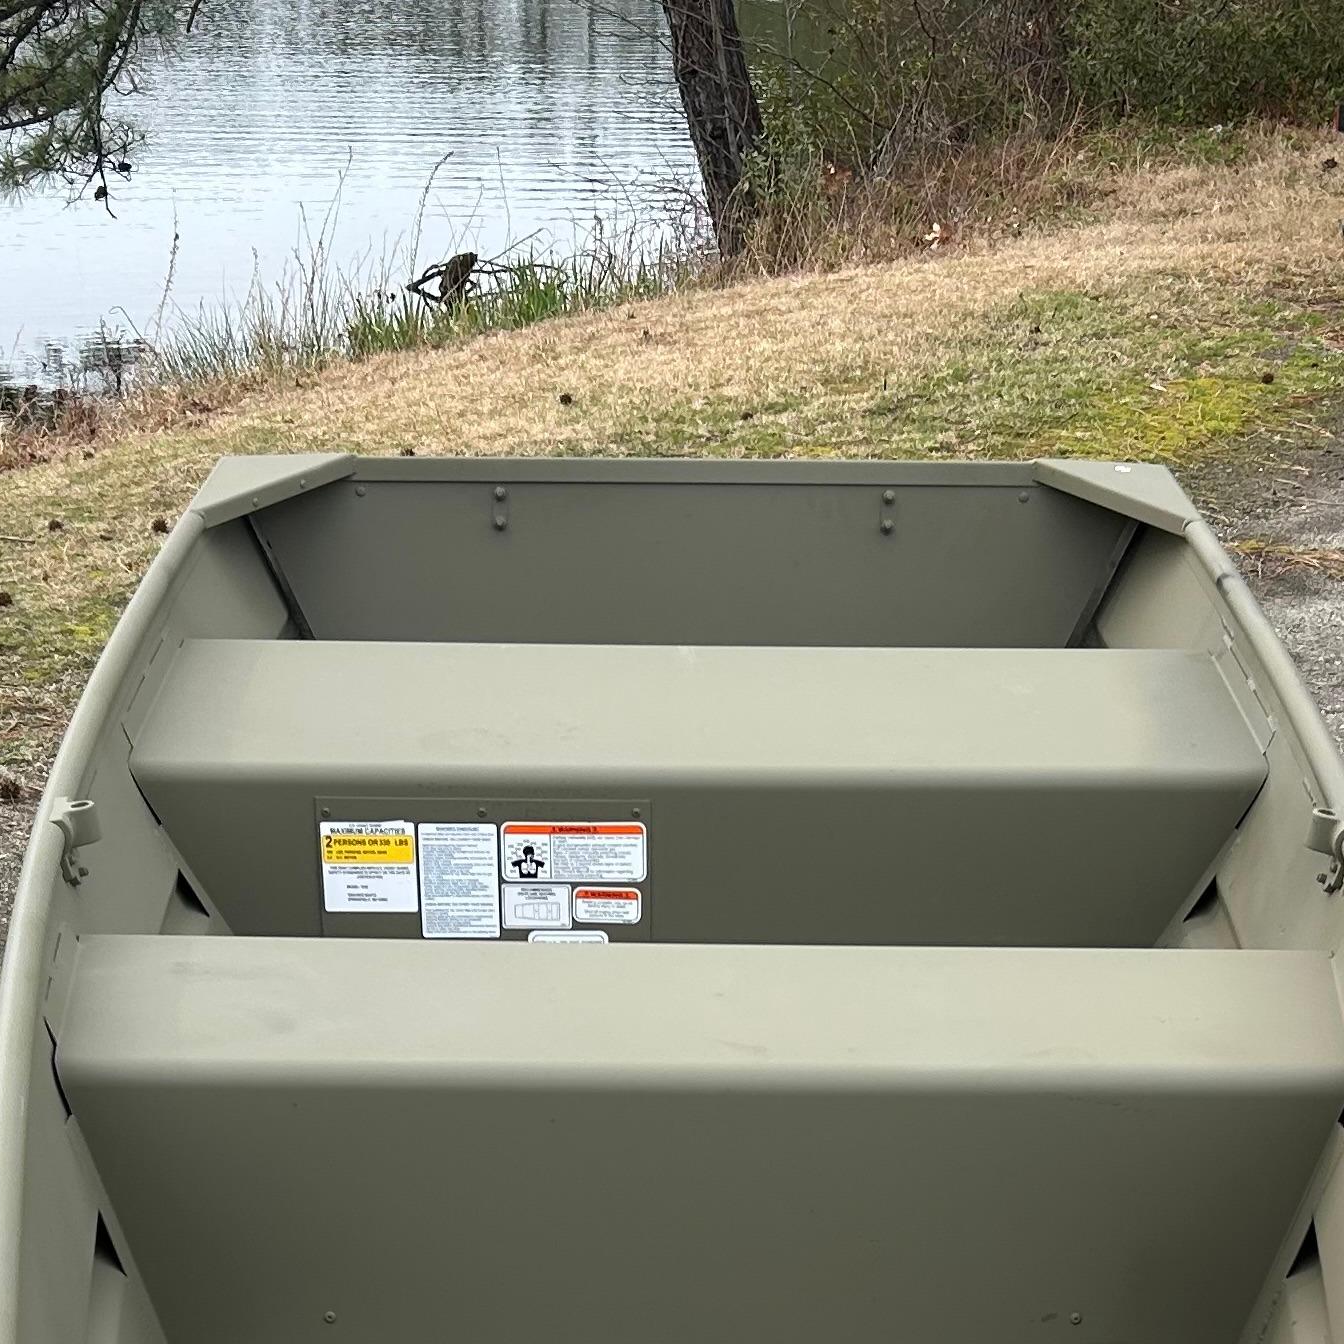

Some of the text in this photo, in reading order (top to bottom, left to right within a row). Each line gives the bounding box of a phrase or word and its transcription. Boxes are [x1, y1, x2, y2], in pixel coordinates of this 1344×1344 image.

[325, 835, 333, 848] 2
[333, 838, 366, 846] PERSONS
[368, 838, 378, 846] OR
